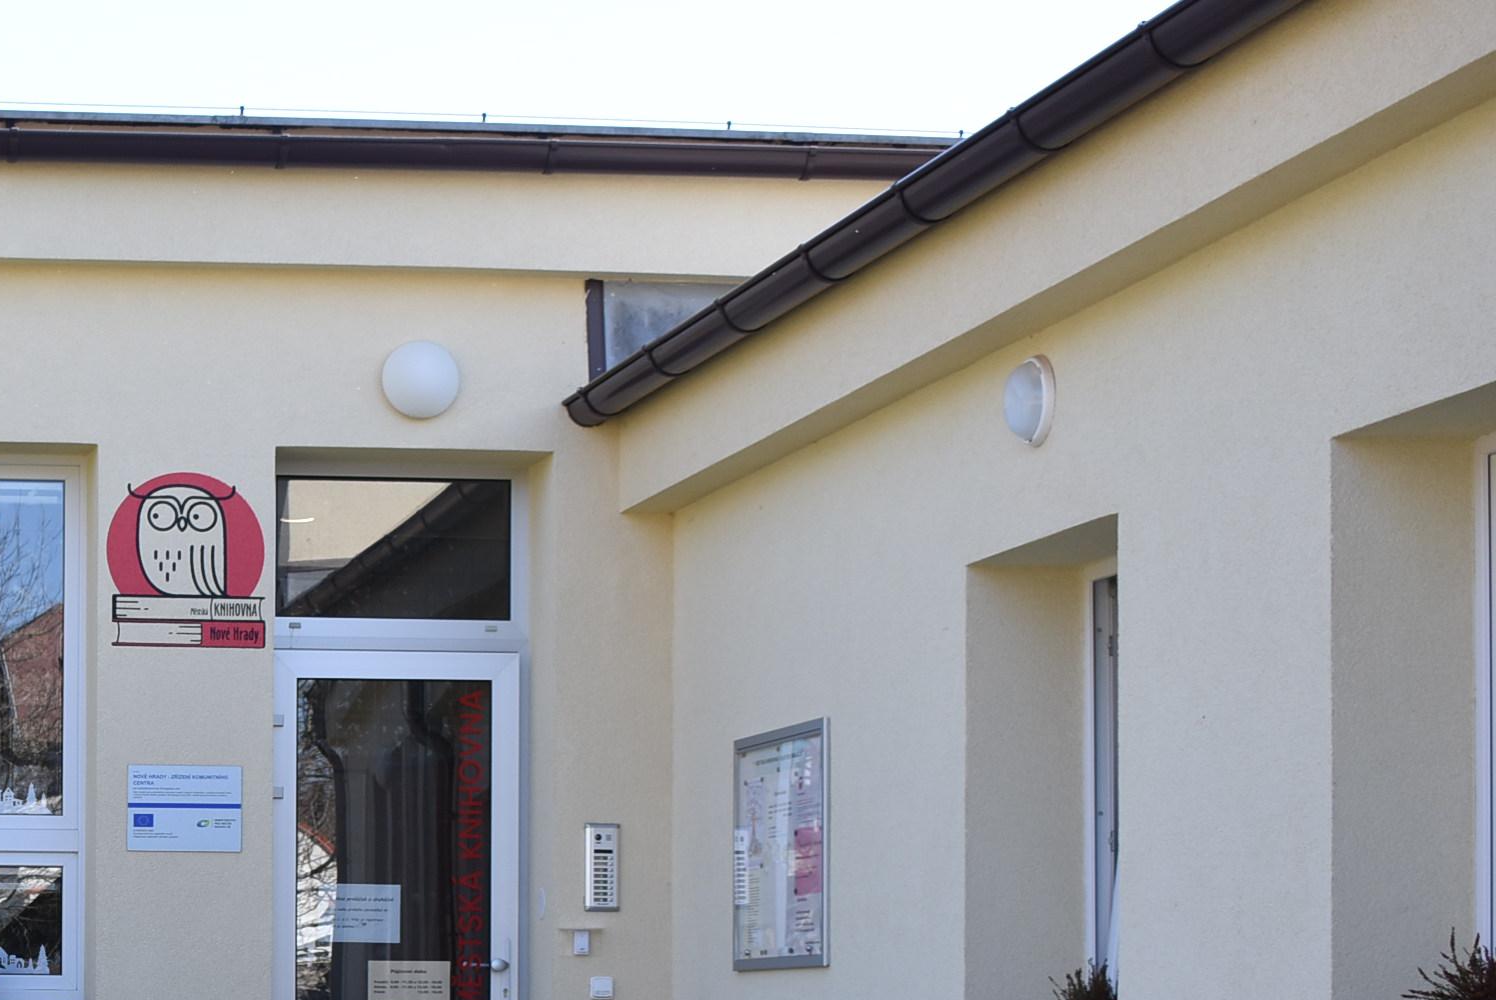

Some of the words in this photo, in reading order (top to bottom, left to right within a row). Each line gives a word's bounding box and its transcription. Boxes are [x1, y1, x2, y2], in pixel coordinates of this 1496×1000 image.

[214, 602, 257, 617] KNIHOVNA
[209, 626, 230, 641] Nové
[233, 626, 259, 644] Hrady
[457, 688, 484, 861] KNIHOVNA
